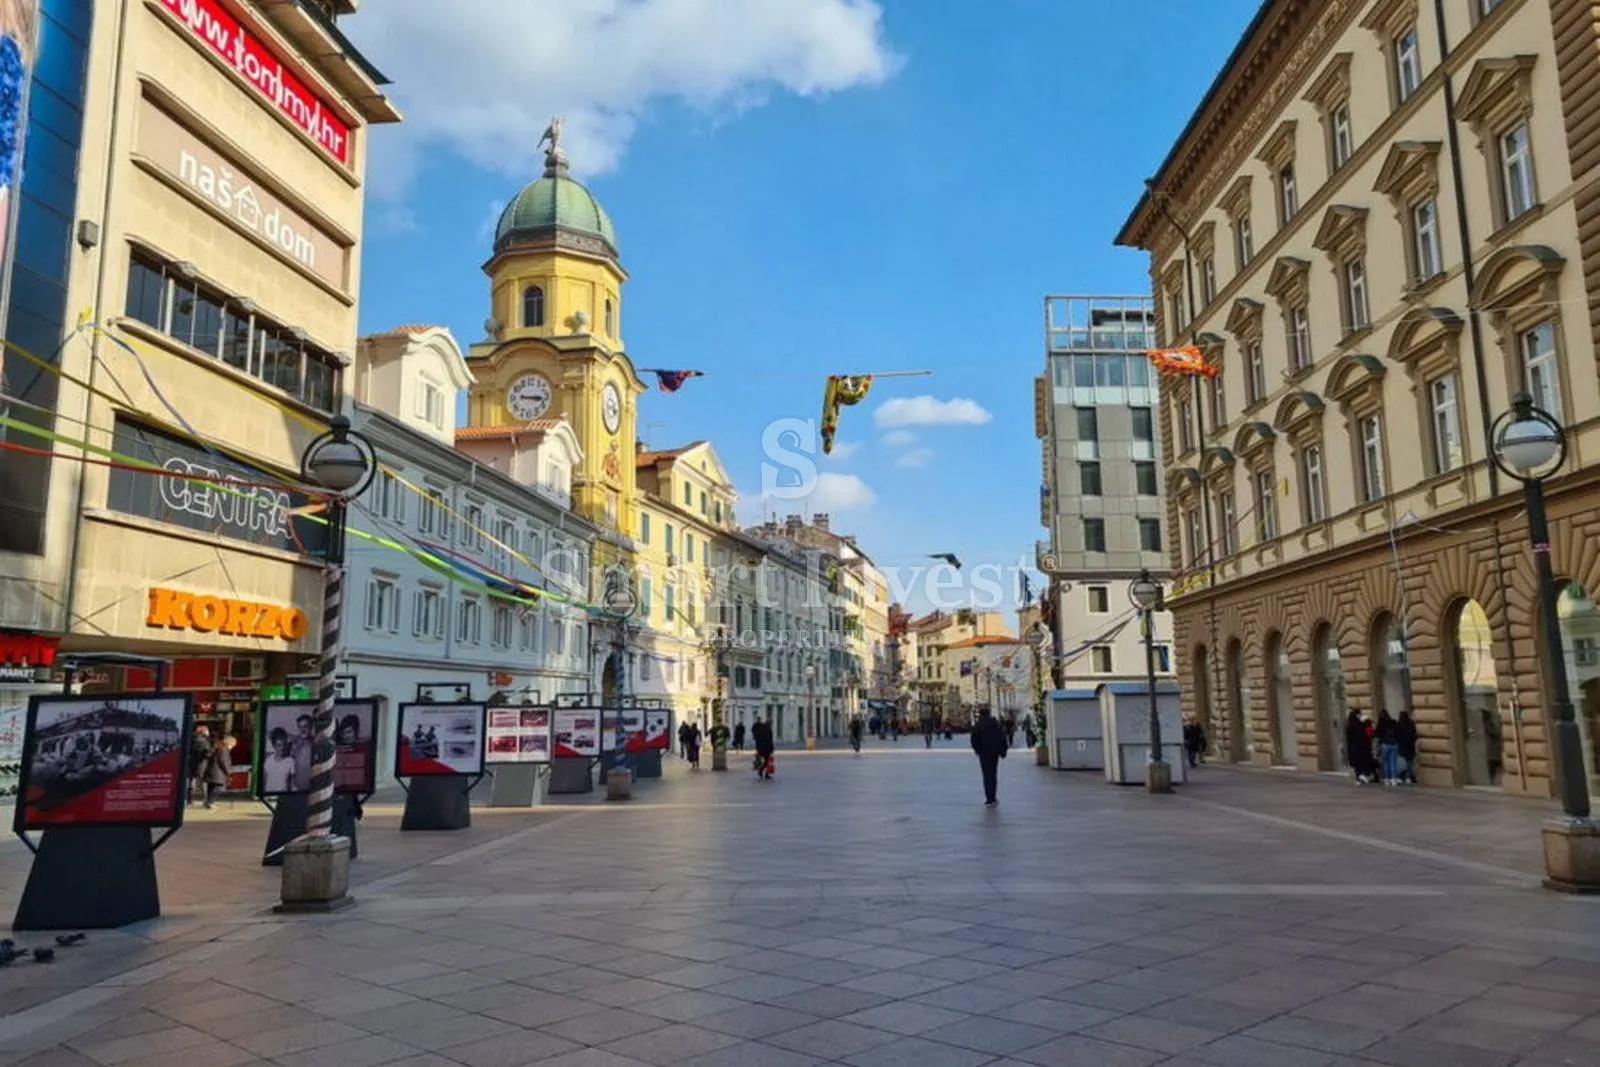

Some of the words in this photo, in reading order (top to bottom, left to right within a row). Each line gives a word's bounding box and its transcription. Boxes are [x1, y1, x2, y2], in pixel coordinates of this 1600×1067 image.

[165, 0, 344, 153] ww.tommy.hr
[180, 150, 233, 209] naš
[263, 207, 315, 267] dom
[159, 457, 294, 540] CENTRA
[146, 587, 309, 641] KORZO
